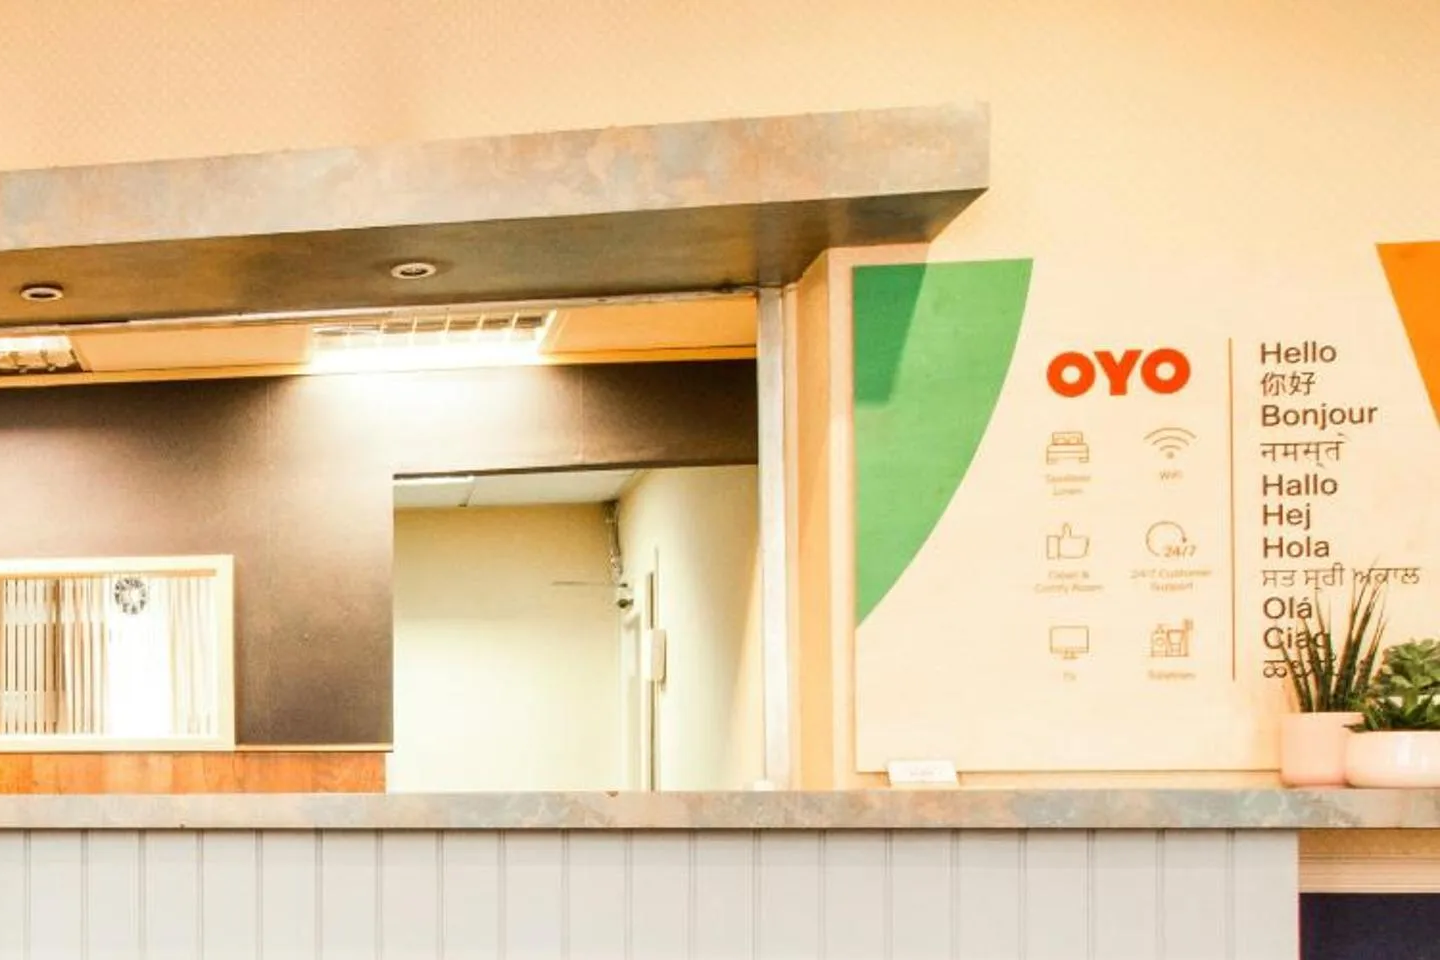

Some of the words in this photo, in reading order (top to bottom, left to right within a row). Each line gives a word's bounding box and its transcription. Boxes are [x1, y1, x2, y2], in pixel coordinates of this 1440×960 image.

[1260, 340, 1337, 364] Hello
[1046, 347, 1192, 398] OYO
[1260, 370, 1316, 396] 你好
[1261, 402, 1378, 430] Bonjour
[1262, 473, 1338, 496] Hallo
[1262, 502, 1311, 531] Hej
[1263, 536, 1330, 558] Hola
[1263, 596, 1312, 620] Olá
